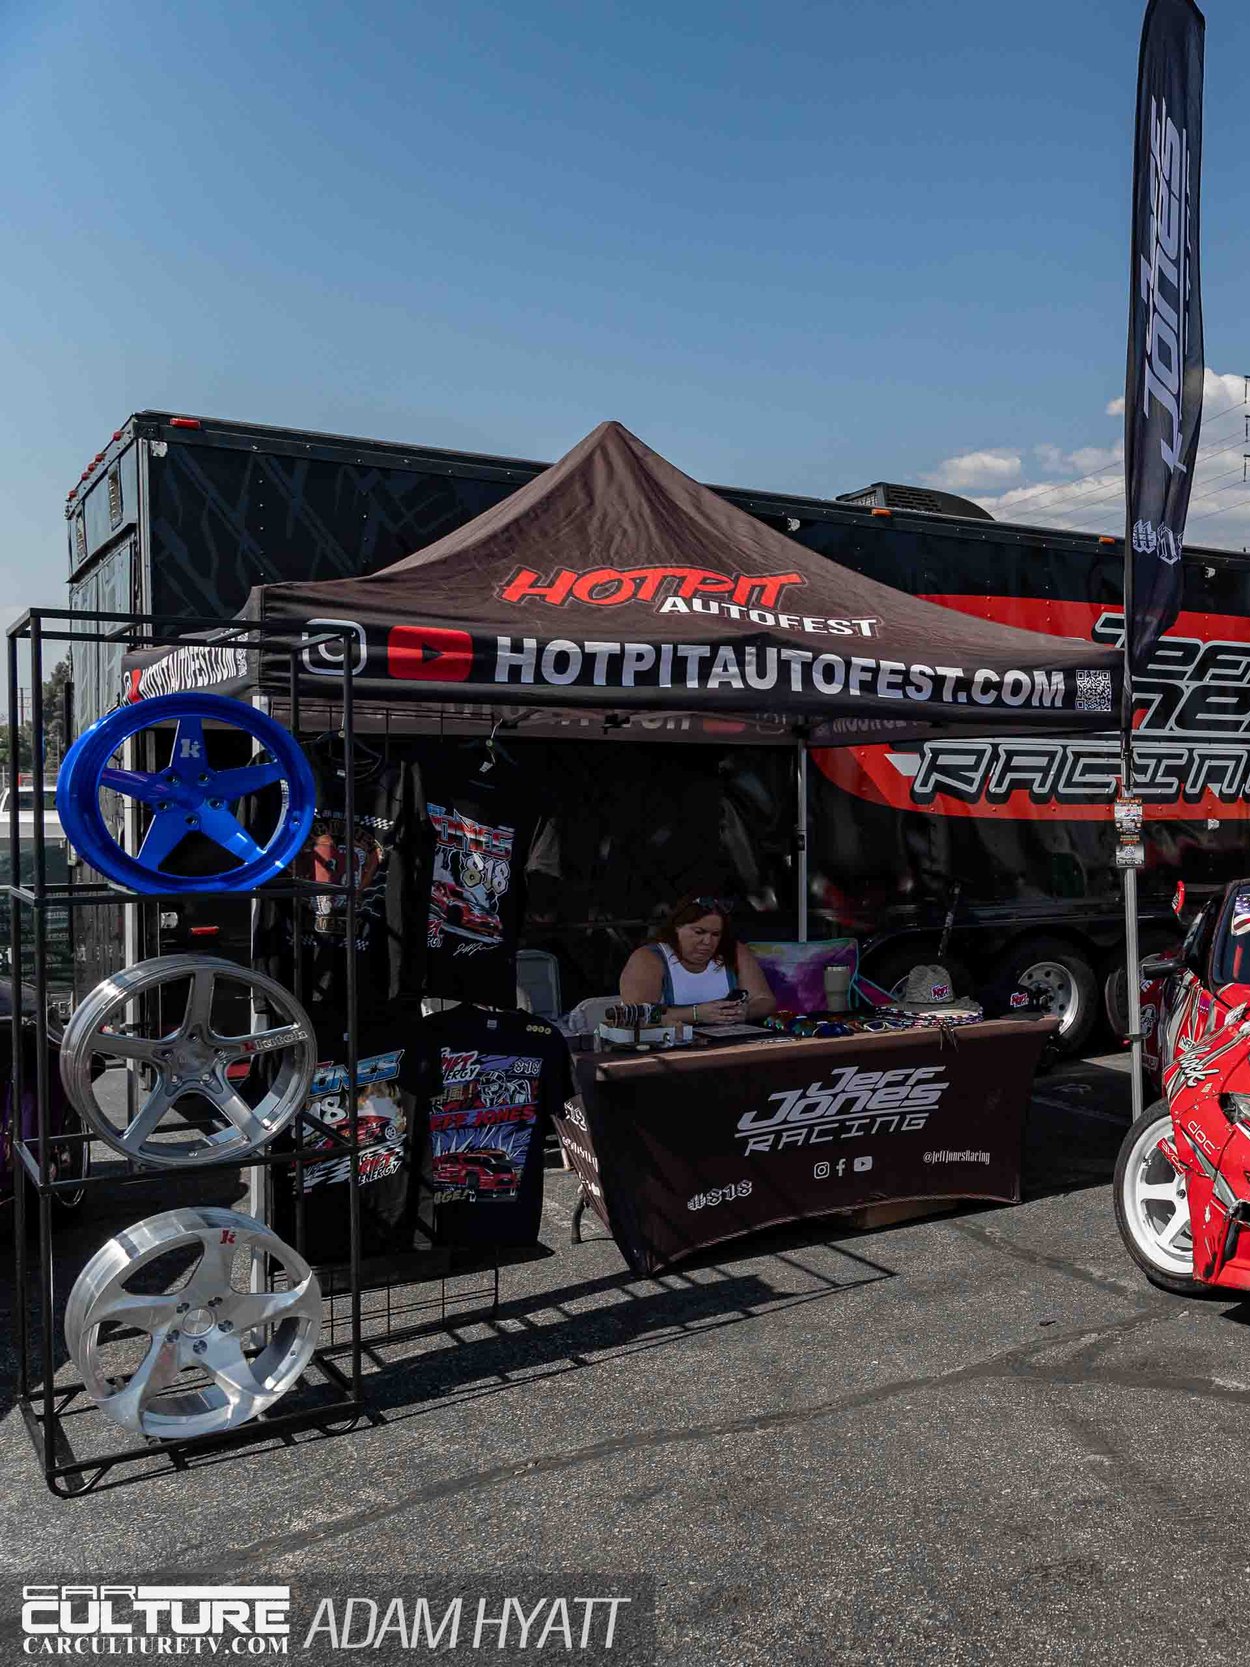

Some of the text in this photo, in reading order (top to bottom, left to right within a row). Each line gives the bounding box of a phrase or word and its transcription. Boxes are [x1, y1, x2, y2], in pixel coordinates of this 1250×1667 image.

[500, 565, 803, 606] HOTPIT
[658, 595, 877, 638] AUTOFEST
[494, 635, 1065, 708] HOTPITAUTOFEST.COM
[461, 852, 511, 896] 818
[513, 1060, 541, 1075] 818
[473, 1104, 537, 1127] JONES
[744, 1112, 930, 1157] RACING
[687, 1179, 753, 1212] #818
